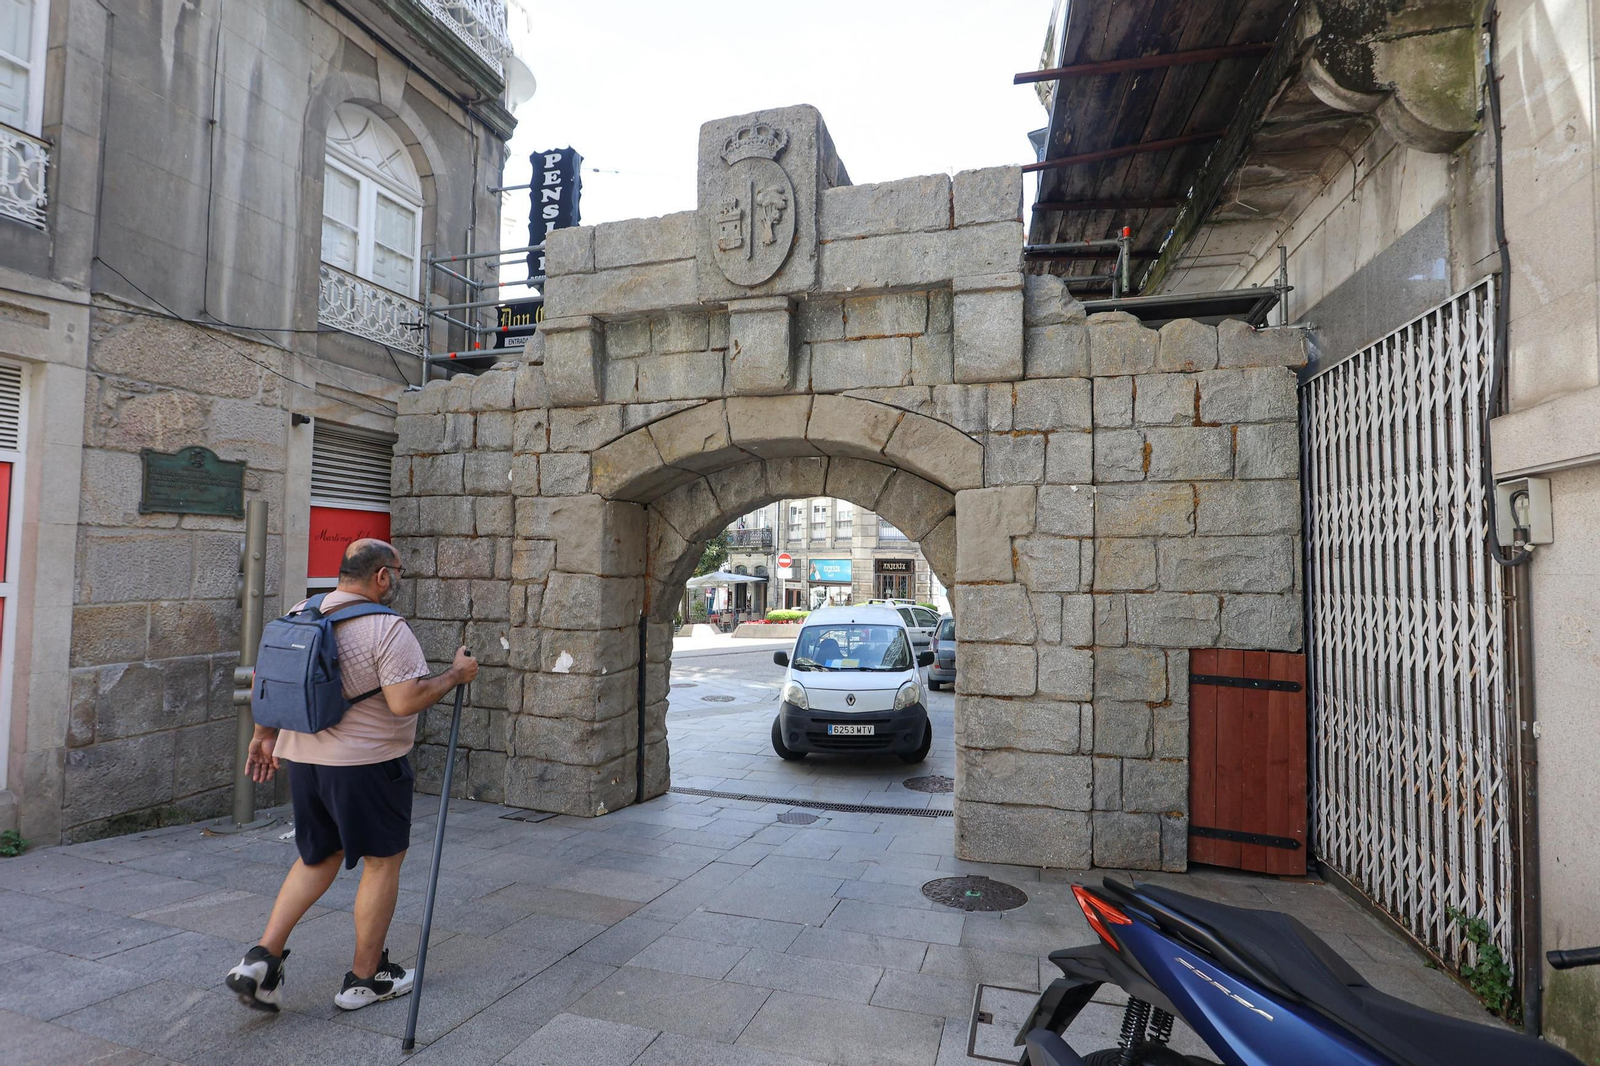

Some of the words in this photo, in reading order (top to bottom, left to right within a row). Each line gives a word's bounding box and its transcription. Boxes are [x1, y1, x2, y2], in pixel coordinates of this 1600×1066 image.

[538, 153, 562, 270] PENSI
[834, 726, 855, 734] 6253
[856, 726, 873, 734] MTV
